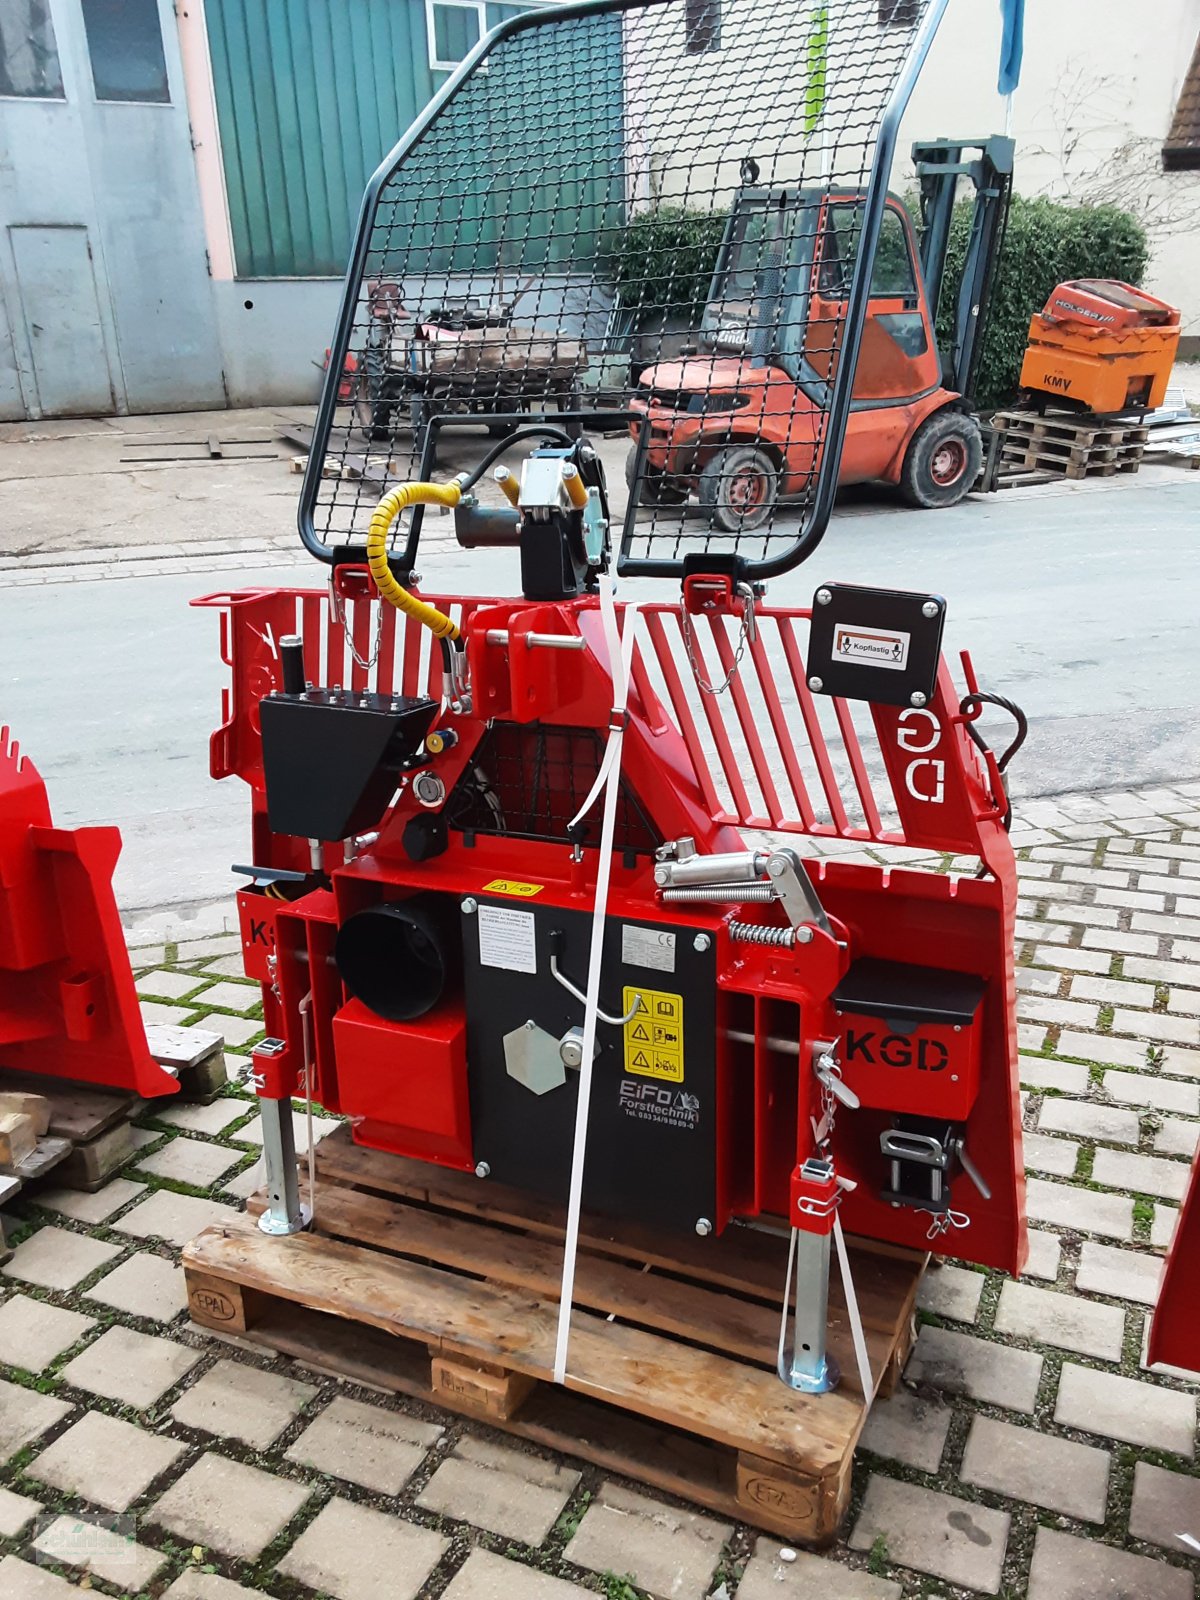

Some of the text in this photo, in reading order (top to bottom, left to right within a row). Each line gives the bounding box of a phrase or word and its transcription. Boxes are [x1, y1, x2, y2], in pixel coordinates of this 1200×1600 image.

[854, 643, 889, 655] Kopflastig
[847, 1030, 948, 1071] KGD
[619, 1096, 695, 1121] Forsttechnik
